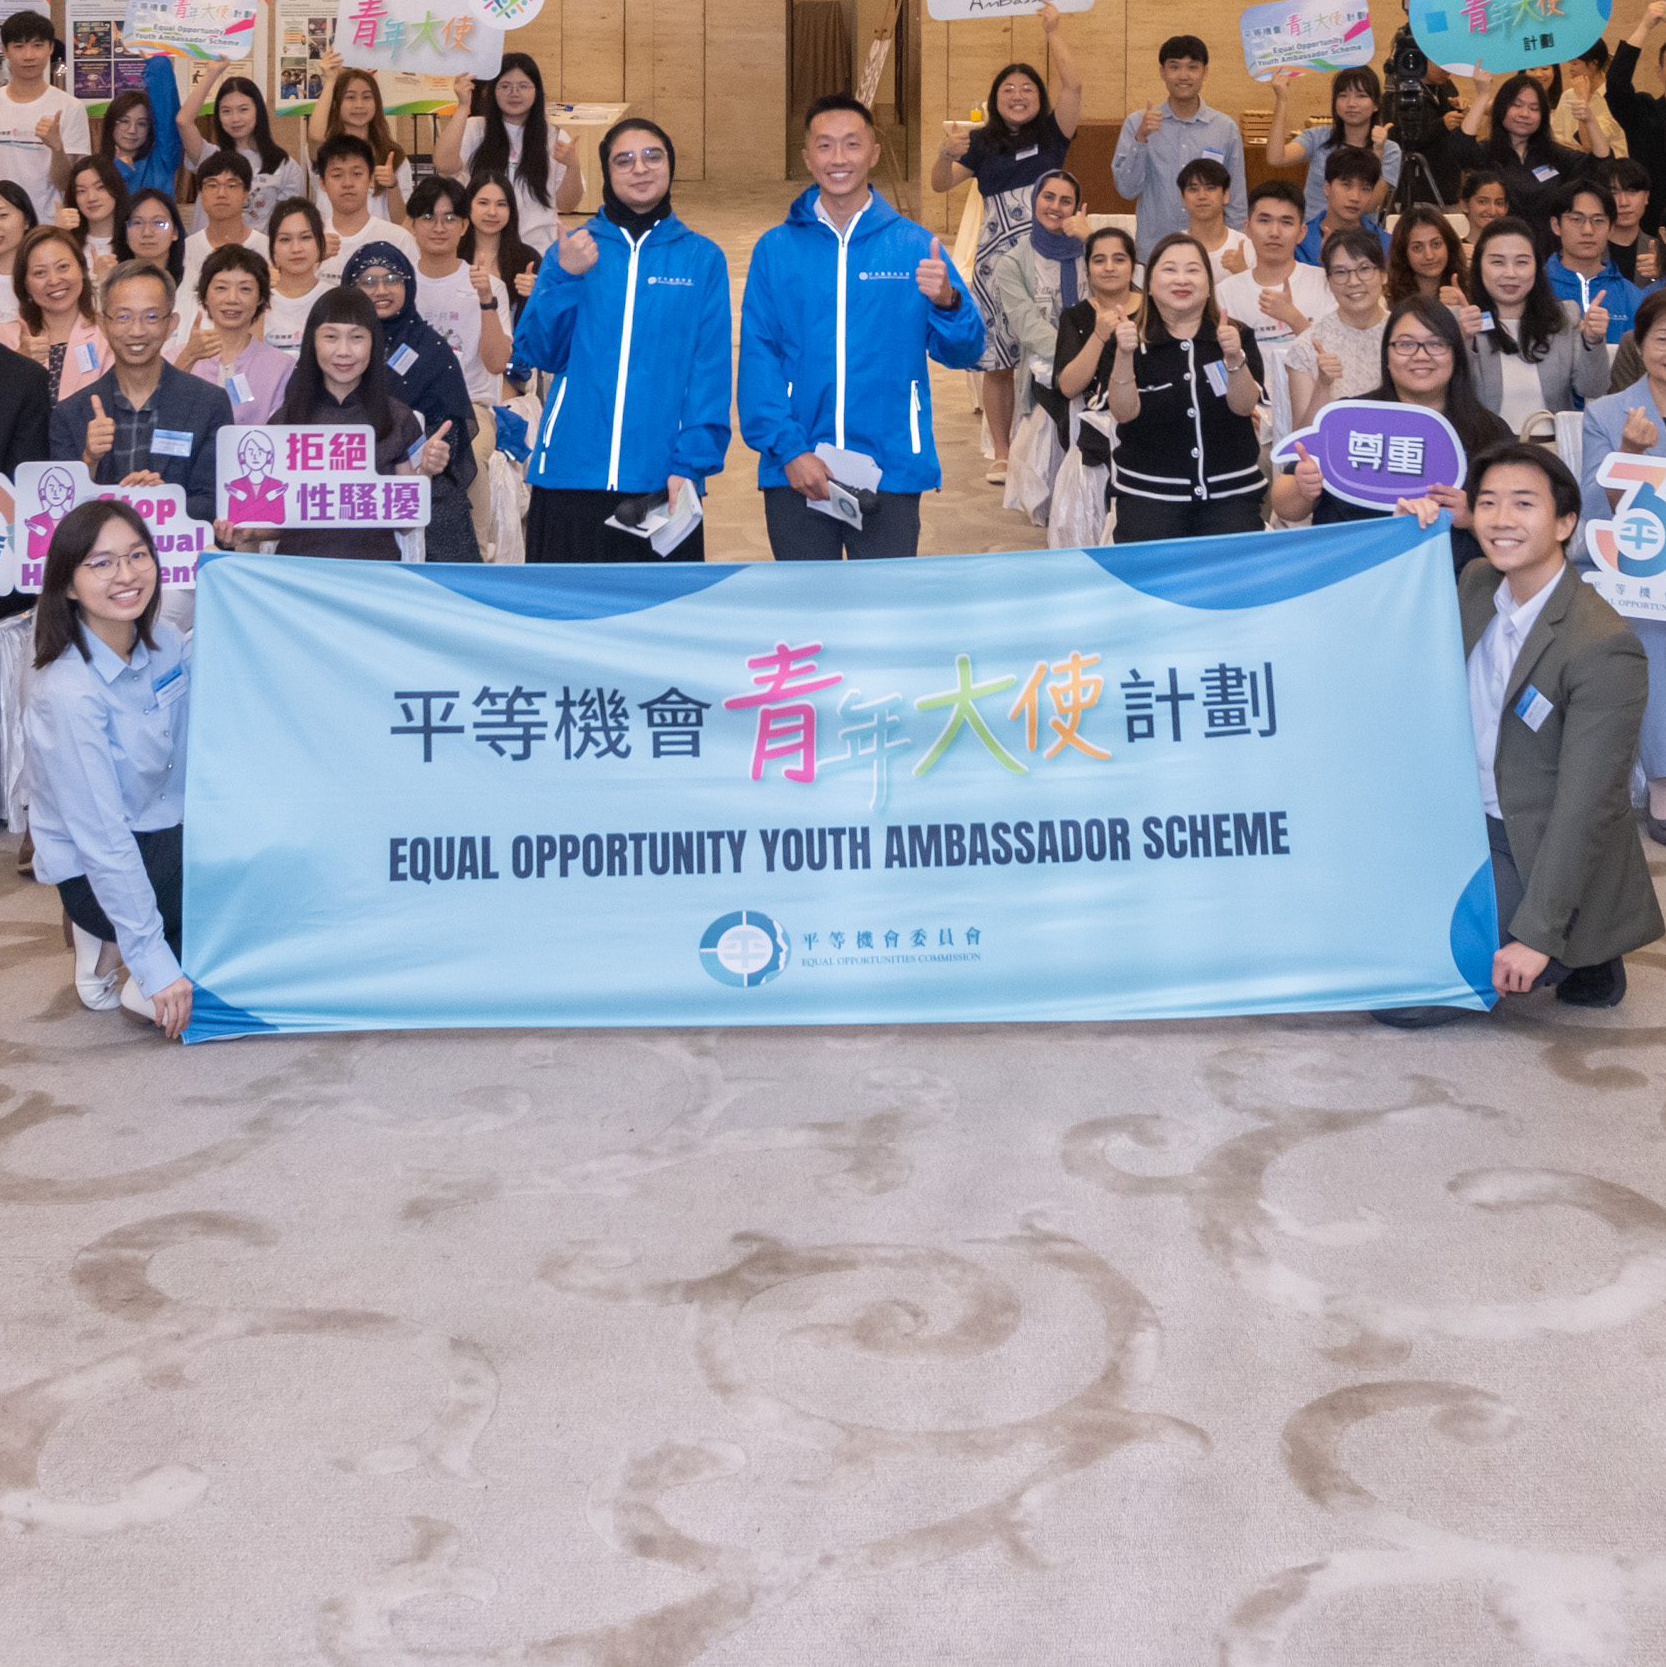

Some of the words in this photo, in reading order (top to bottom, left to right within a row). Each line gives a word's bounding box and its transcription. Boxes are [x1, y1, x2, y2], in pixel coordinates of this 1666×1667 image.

[135, 32, 157, 40] Youth
[158, 34, 207, 44] Ambassador
[209, 37, 240, 47] Scheme
[153, 23, 175, 33] Equal
[177, 25, 225, 36] Opportunity
[1272, 45, 1295, 55] Equal
[1296, 36, 1343, 50] Opportunity
[1523, 32, 1555, 52] 計劃
[1257, 58, 1279, 67] Youth
[1281, 49, 1329, 63] Ambassador
[1331, 44, 1363, 55] Scheme
[286, 432, 368, 472] 拒絕
[1347, 430, 1425, 475] 尊重
[296, 482, 421, 521] 性騷擾
[389, 835, 500, 886] EQUAL
[511, 829, 747, 879] OPPORTUNITY
[760, 825, 871, 873] YOUTH
[884, 816, 1132, 869] AMBASSADOR
[1142, 810, 1291, 860] SCHEME
[801, 926, 982, 952] 平等機會委員會
[801, 957, 835, 967] EQUAL
[836, 954, 917, 966] OPPORTUNITIES
[918, 952, 981, 964] COMMISSION
